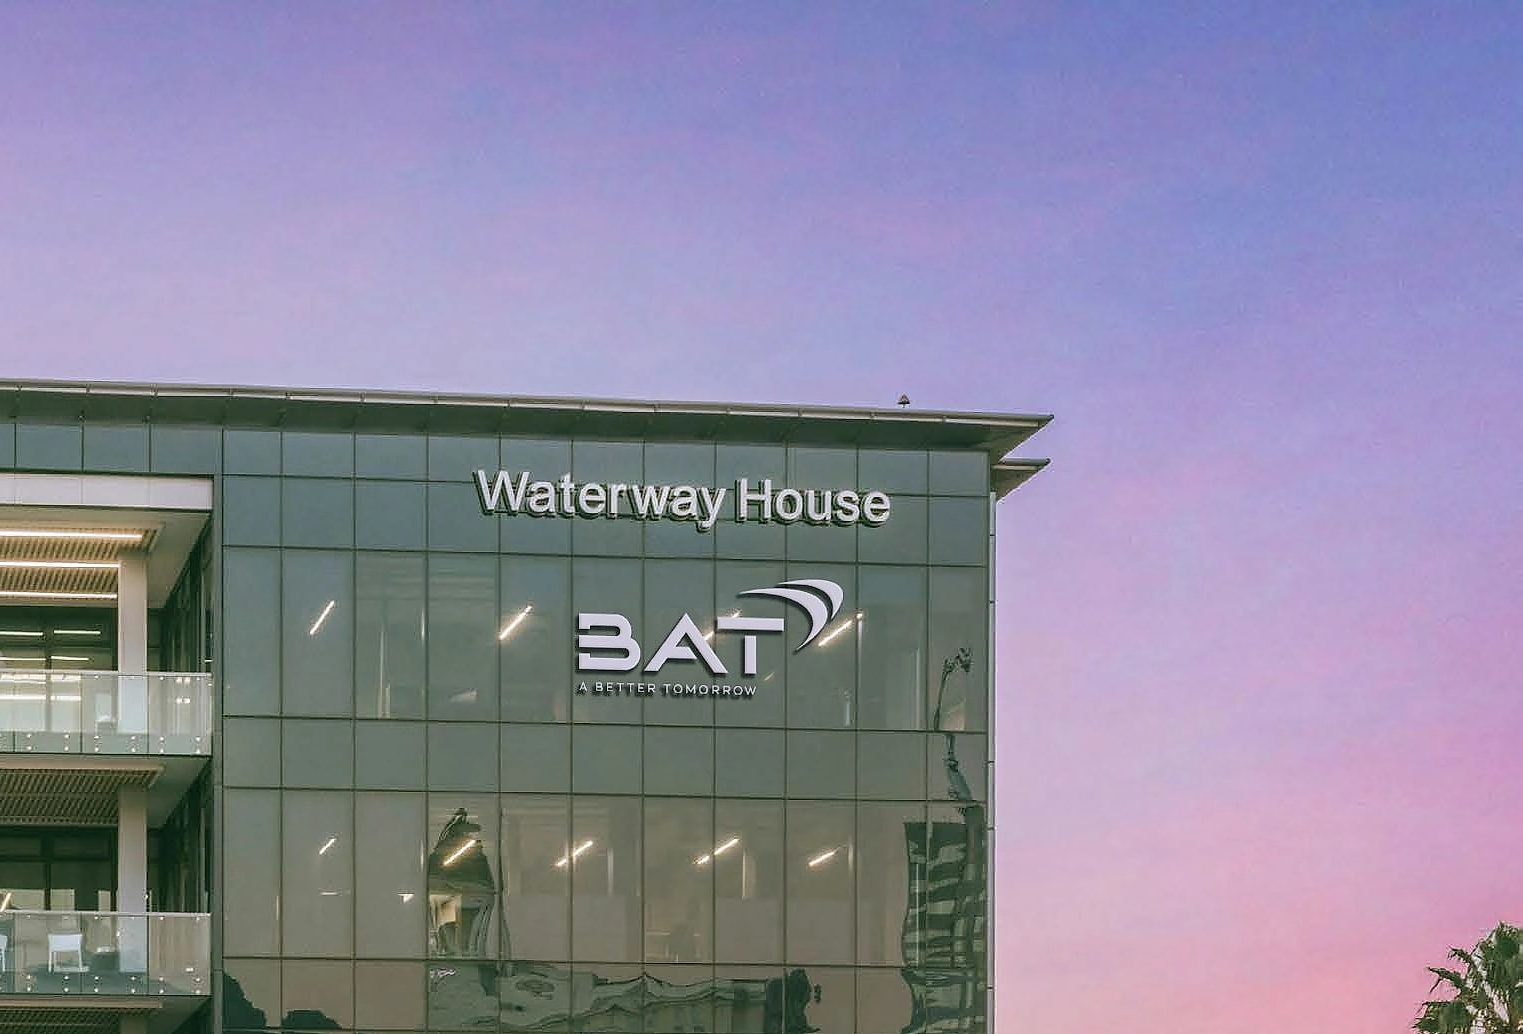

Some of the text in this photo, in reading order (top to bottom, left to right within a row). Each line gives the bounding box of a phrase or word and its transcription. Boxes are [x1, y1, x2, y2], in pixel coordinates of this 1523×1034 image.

[476, 468, 891, 530] Waterway House
[578, 612, 784, 676] BAT
[578, 681, 757, 696] A BETTER TOMORROW
